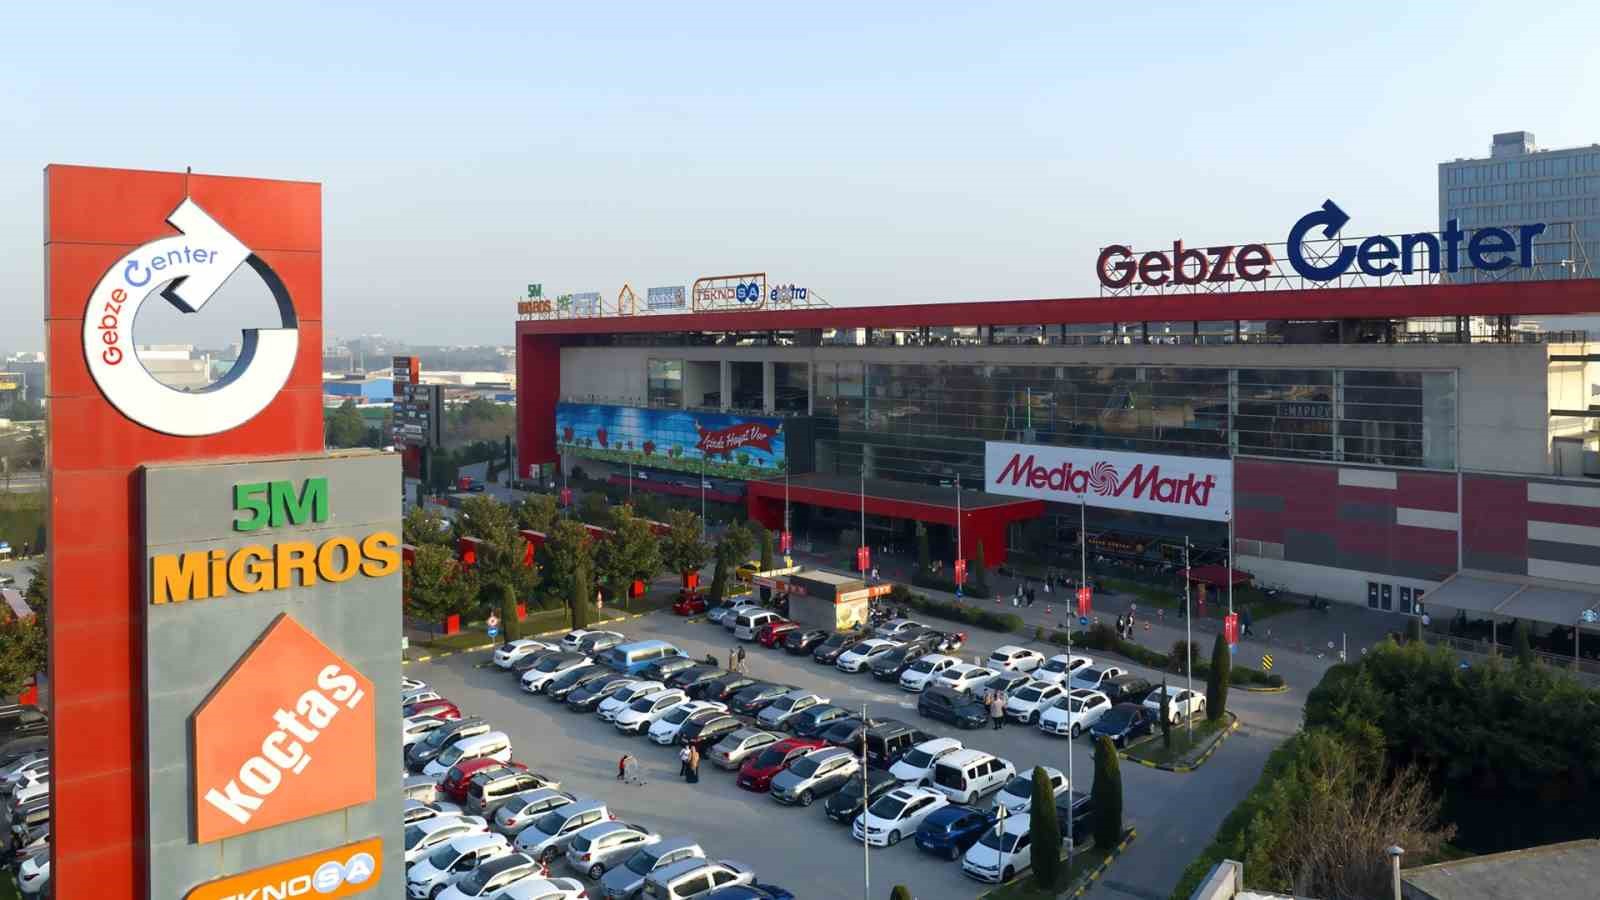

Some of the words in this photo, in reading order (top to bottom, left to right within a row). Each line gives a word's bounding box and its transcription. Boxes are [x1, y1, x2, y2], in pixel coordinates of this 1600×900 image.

[1097, 239, 1273, 289] Gebze
[1287, 199, 1546, 281] Center
[98, 288, 128, 366] Gebze
[124, 246, 219, 288] Center
[232, 477, 329, 532] 5M
[996, 453, 1088, 494] Media
[1112, 463, 1215, 507] Markt
[204, 664, 365, 825] koçtaş
